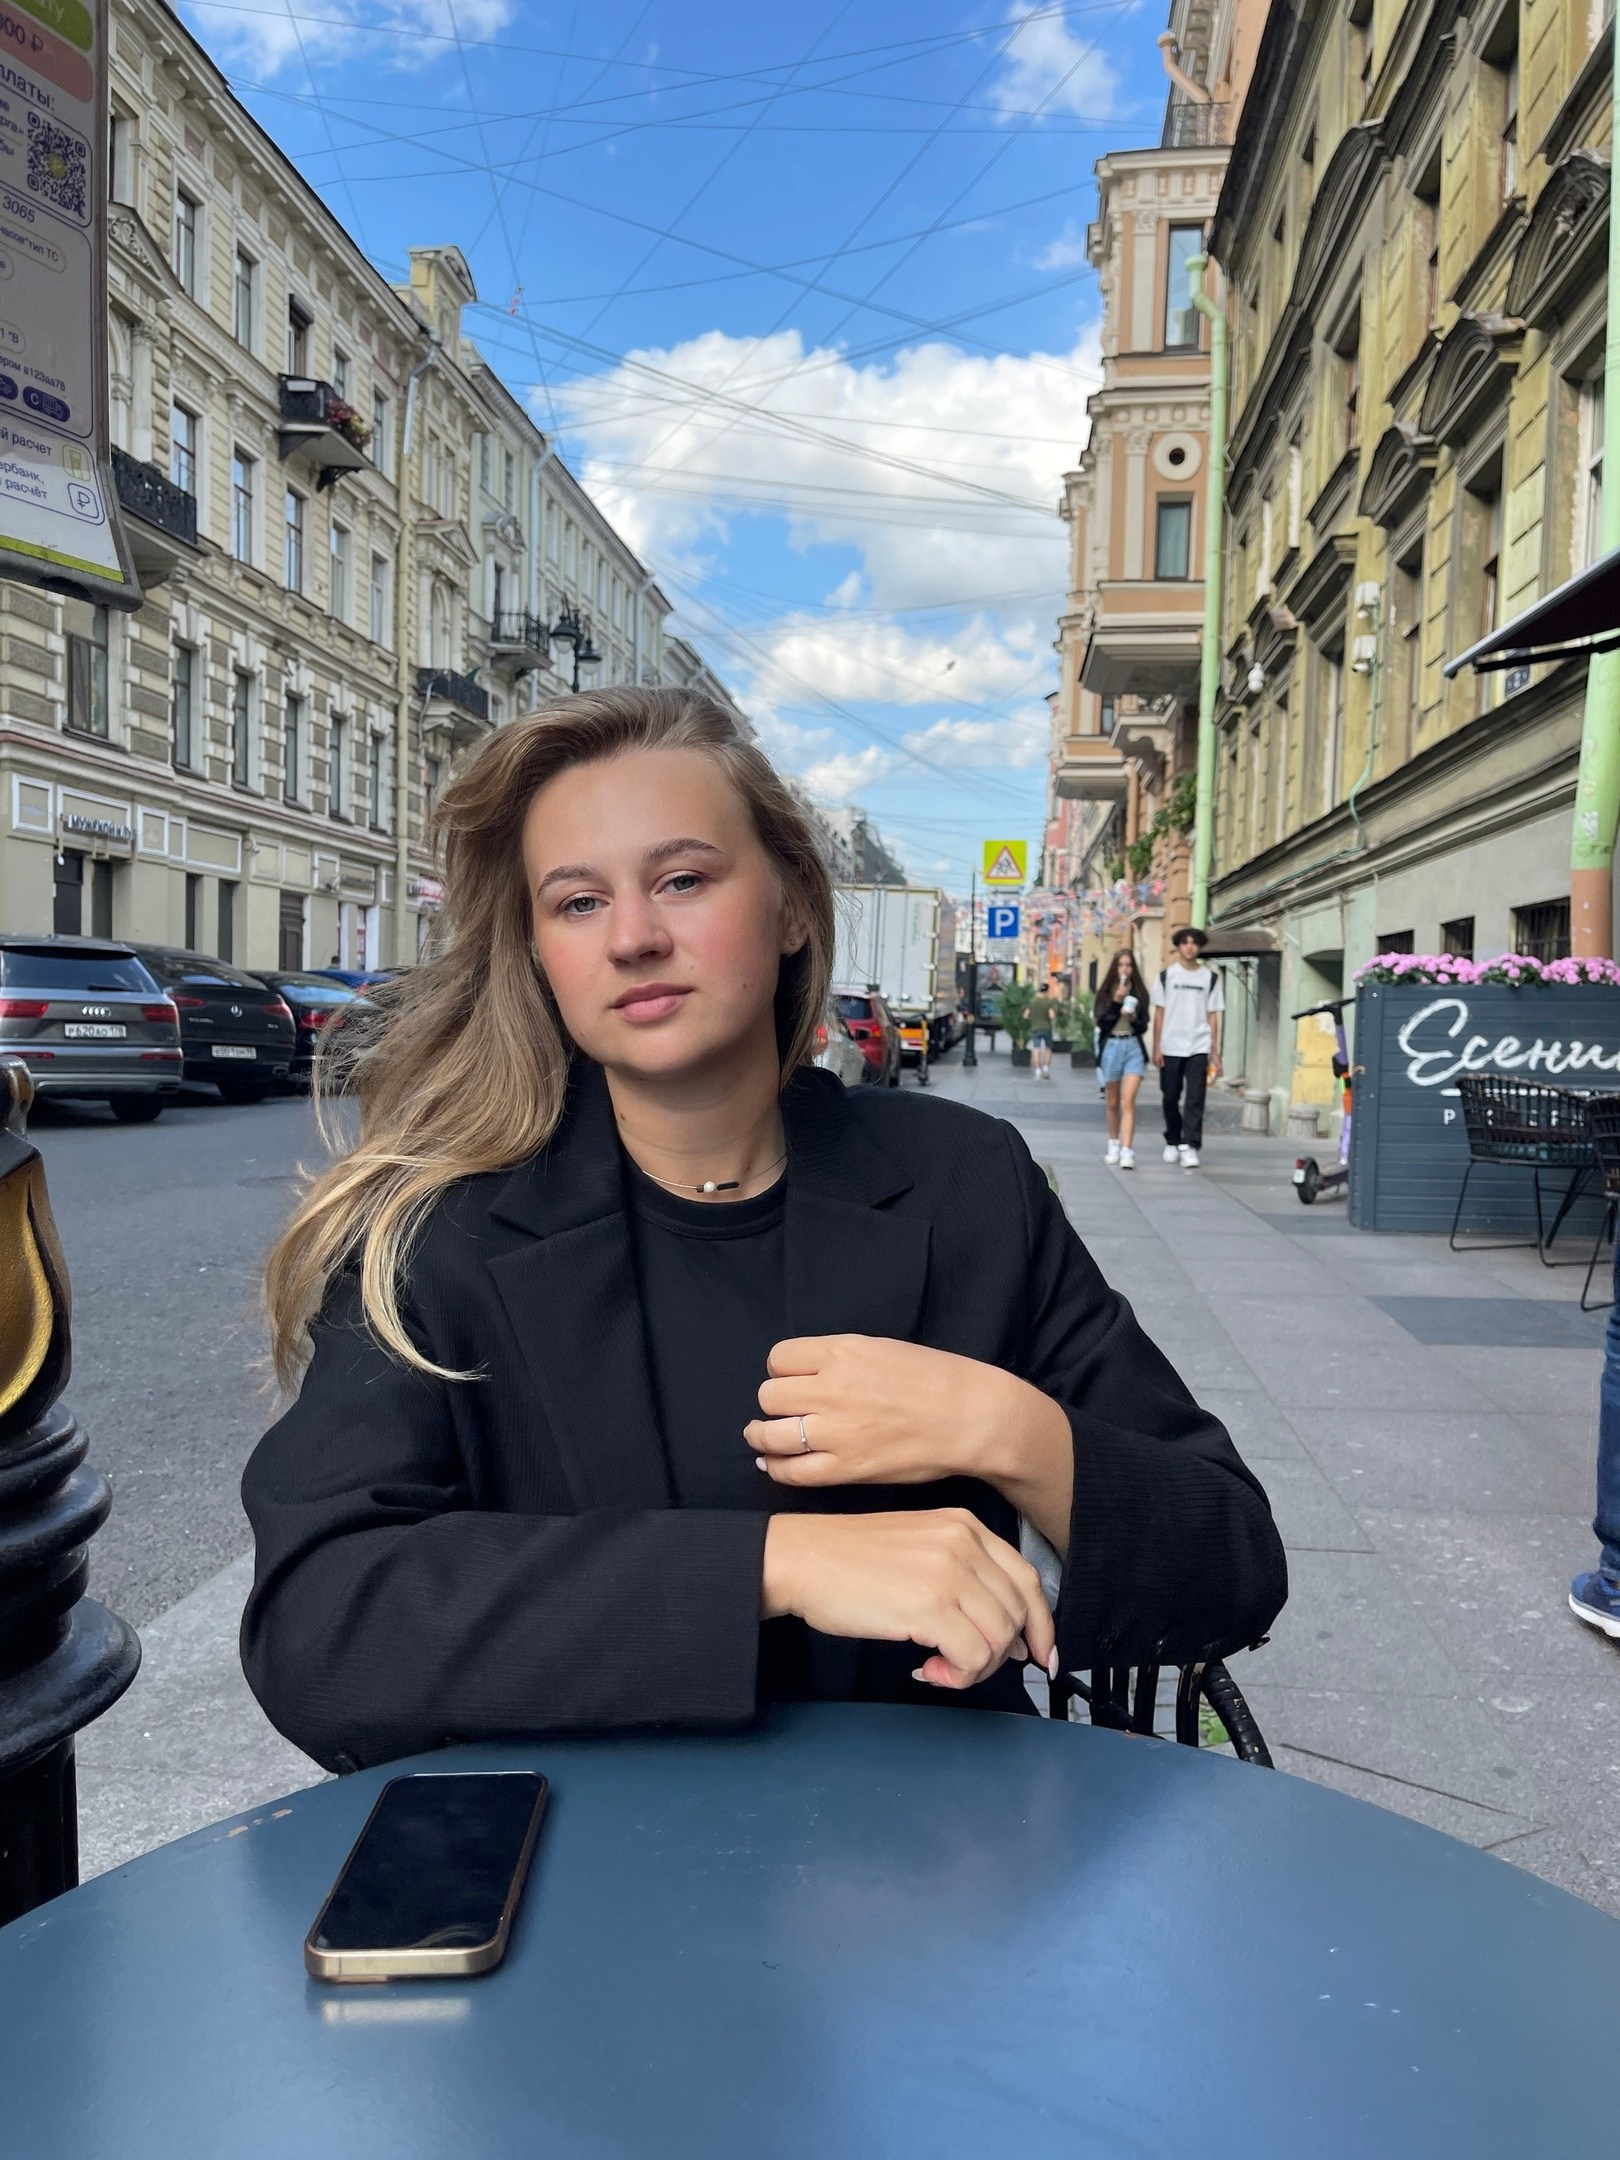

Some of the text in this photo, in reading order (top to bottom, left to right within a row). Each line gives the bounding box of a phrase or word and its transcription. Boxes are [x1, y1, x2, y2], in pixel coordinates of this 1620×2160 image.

[3, 196, 36, 223] 3065
[12, 433, 52, 456] расчет
[995, 909, 1015, 936] P
[1398, 998, 1620, 1087] Есени
